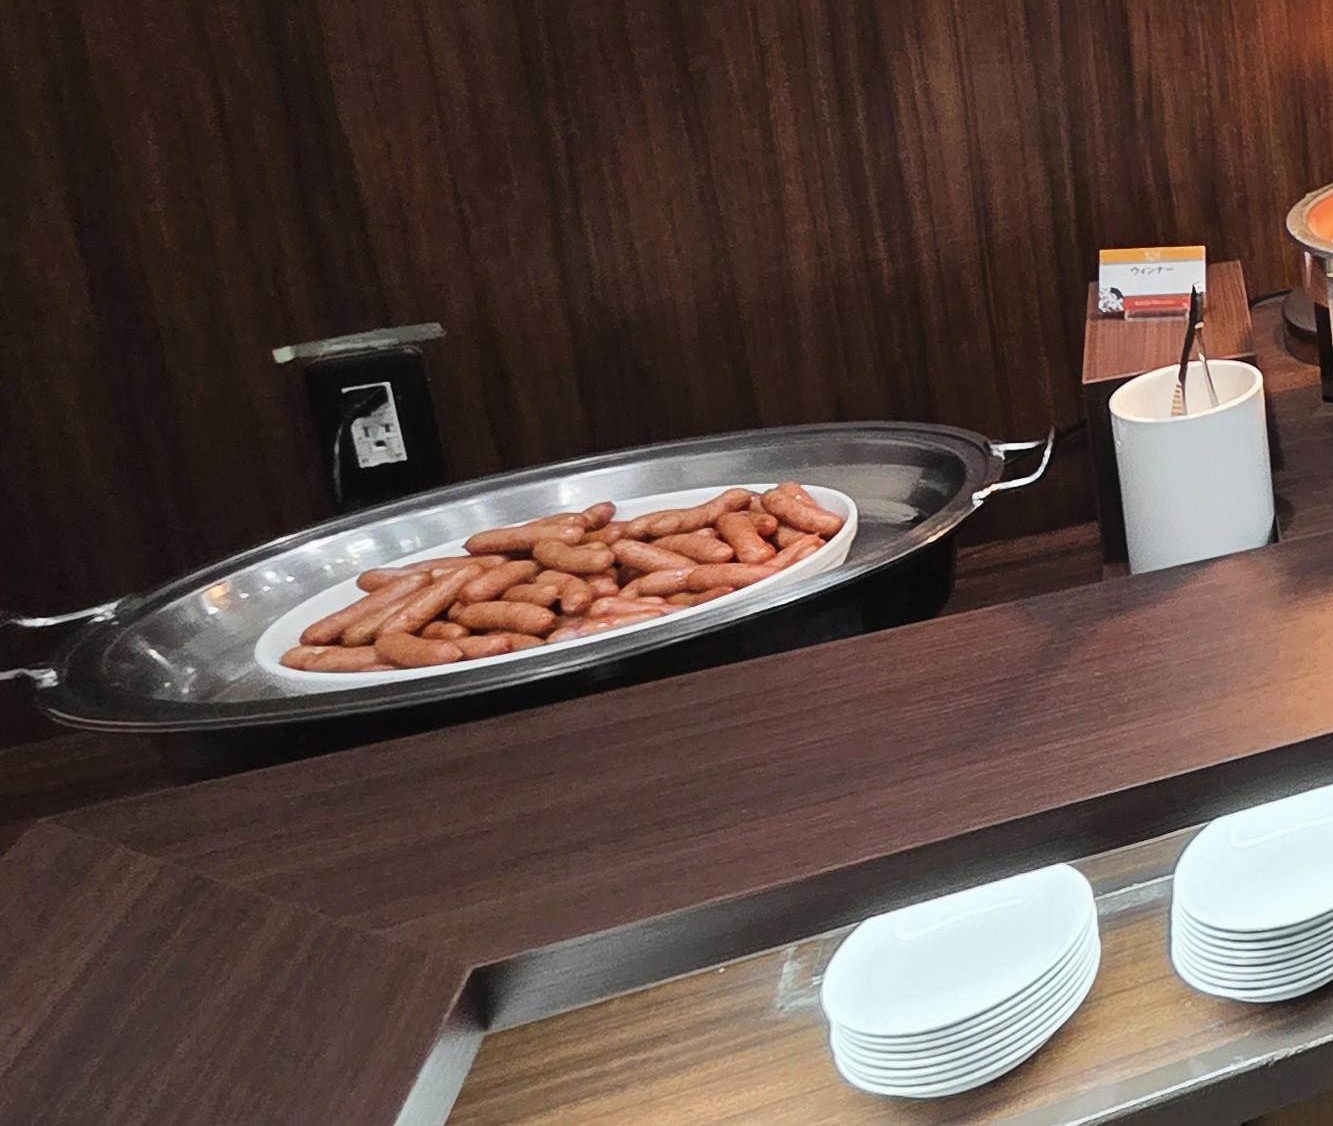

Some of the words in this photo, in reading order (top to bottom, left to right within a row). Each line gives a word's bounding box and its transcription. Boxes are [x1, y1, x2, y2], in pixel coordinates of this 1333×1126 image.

[1130, 266, 1175, 276] ウィンナー
